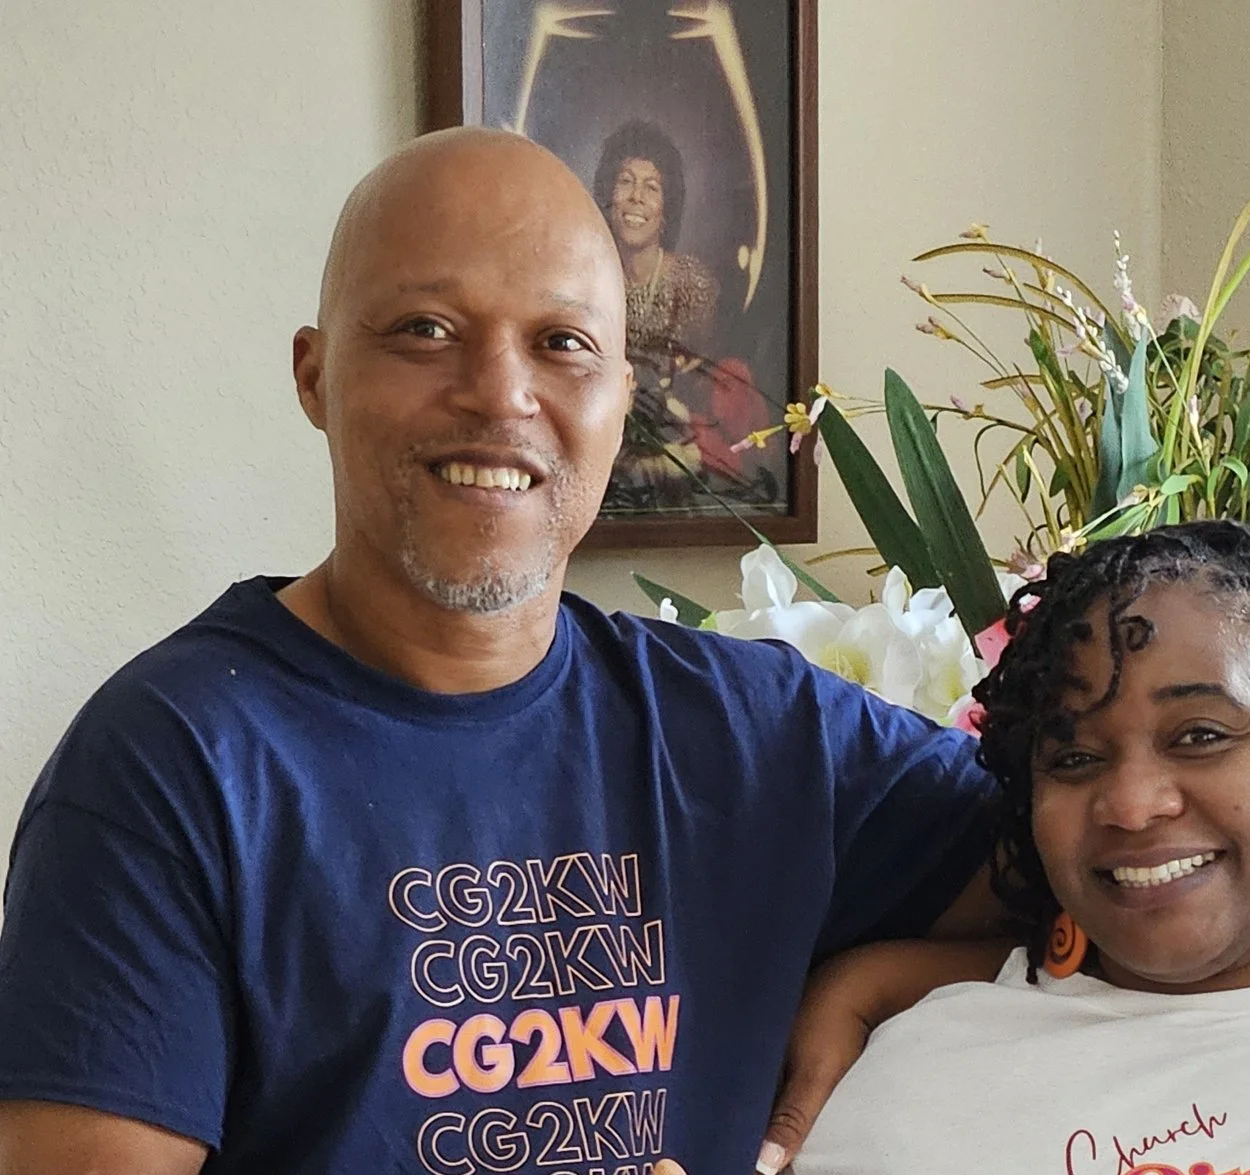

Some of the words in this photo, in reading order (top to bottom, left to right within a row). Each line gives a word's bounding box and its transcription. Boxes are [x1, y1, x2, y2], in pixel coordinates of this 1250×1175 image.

[388, 853, 643, 933] CG2KW
[410, 920, 666, 1007] CG2KW
[402, 995, 681, 1099] CG2KW
